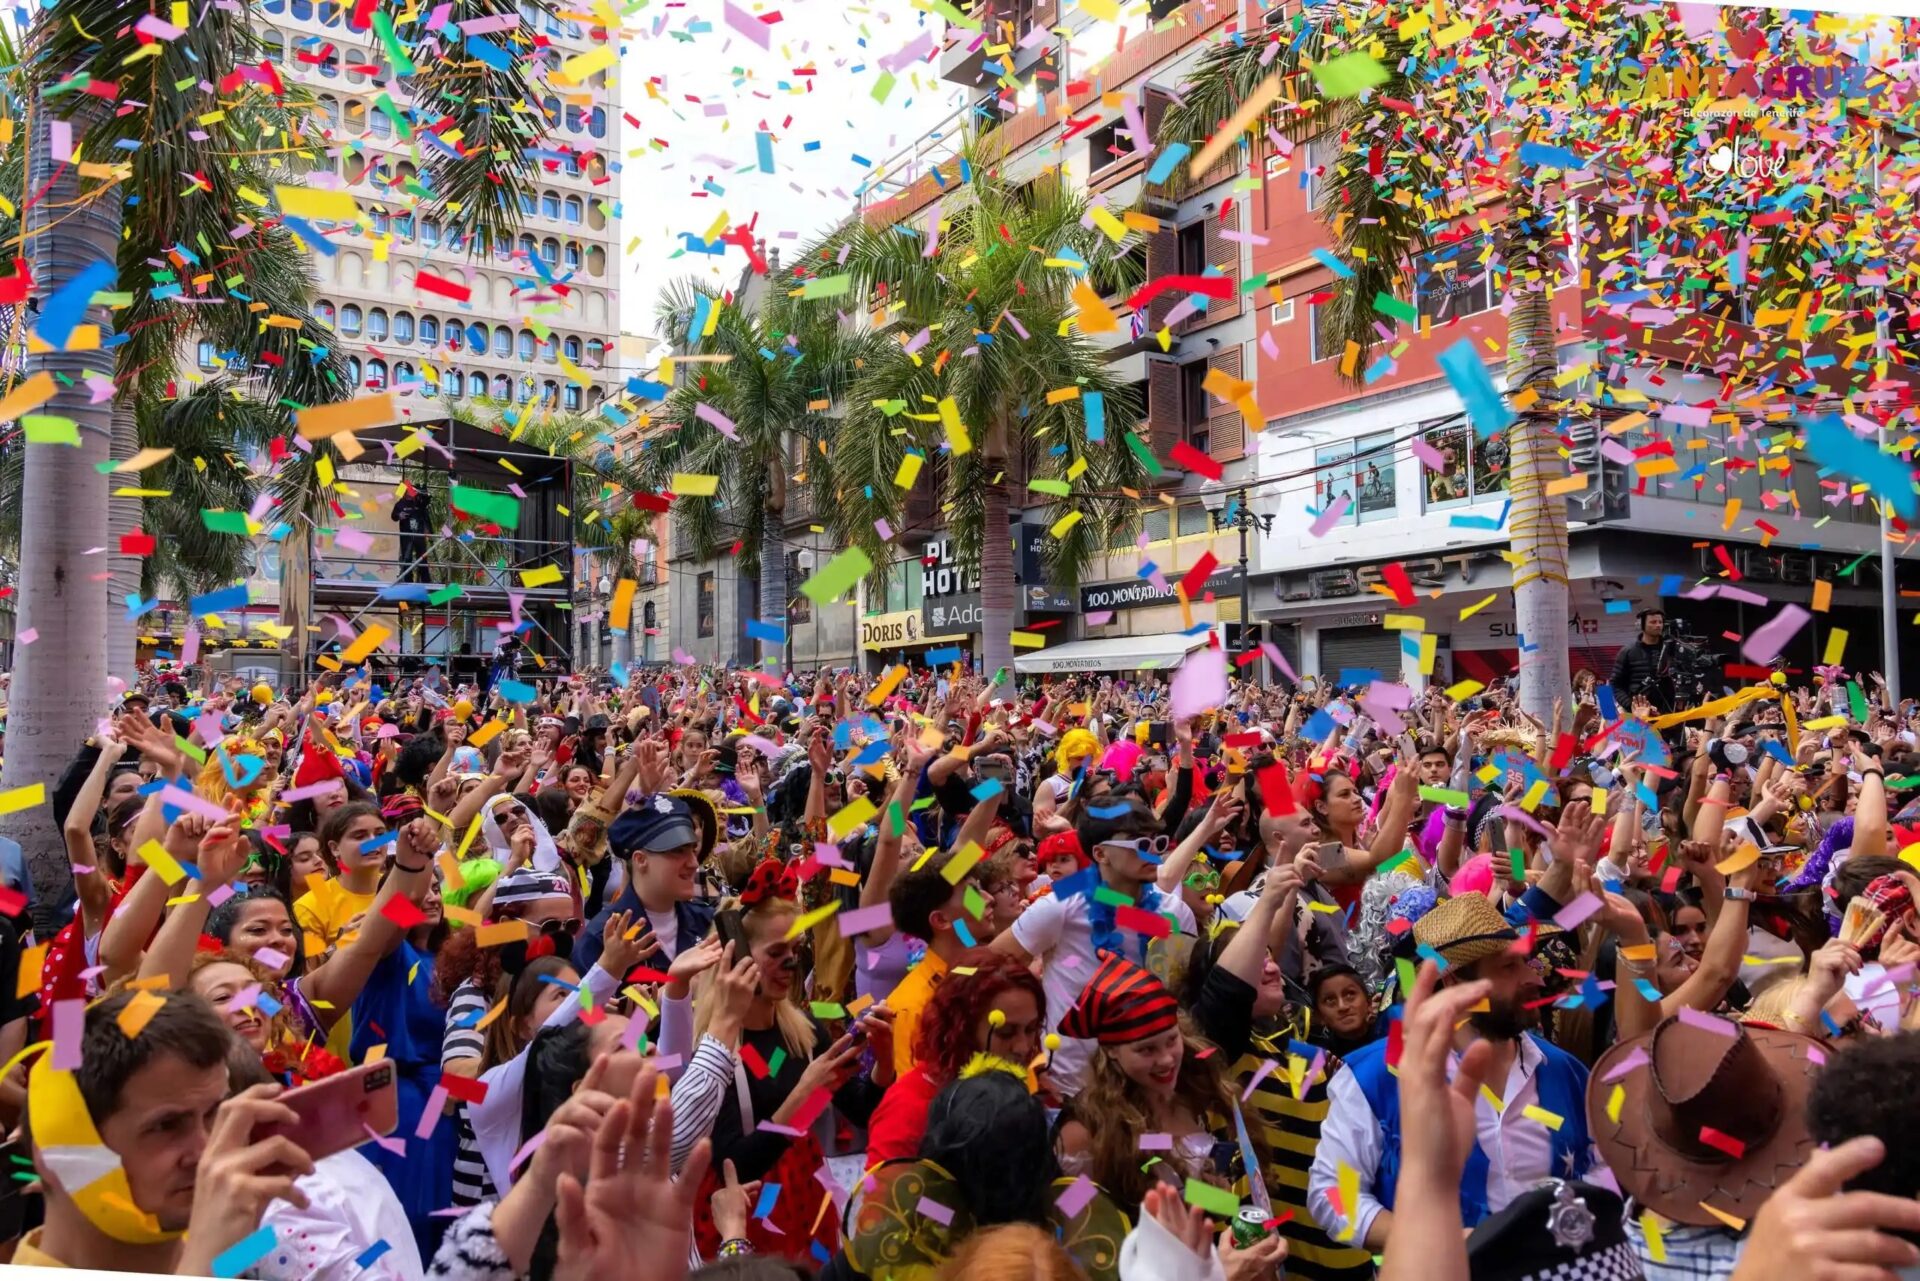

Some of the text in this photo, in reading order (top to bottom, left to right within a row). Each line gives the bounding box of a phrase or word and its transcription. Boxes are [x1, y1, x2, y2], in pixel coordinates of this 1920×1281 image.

[922, 565, 981, 596] HOTE
[1274, 552, 1485, 600] LIBERT
[1087, 593, 1110, 607] 100
[862, 622, 903, 644] DORIS
